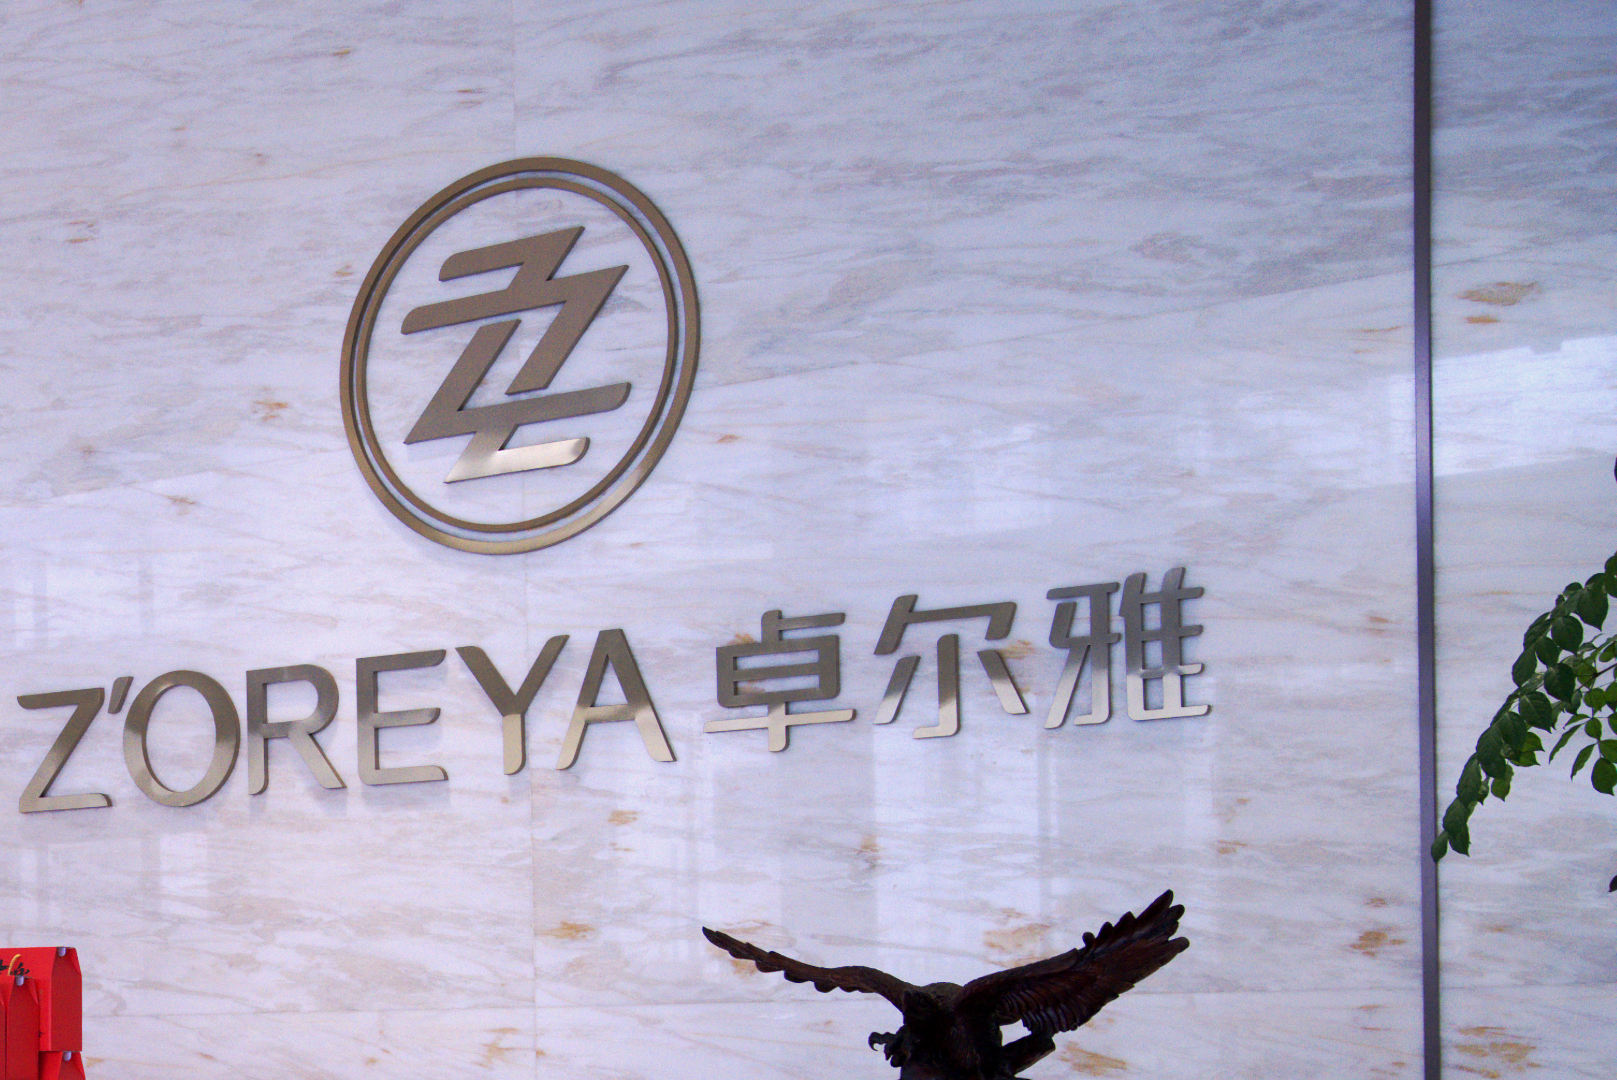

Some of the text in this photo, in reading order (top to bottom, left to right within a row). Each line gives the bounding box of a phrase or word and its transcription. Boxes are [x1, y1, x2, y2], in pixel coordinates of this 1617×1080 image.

[16, 627, 676, 814] Z'OREYA
[703, 566, 1211, 753] 卓尔雅
